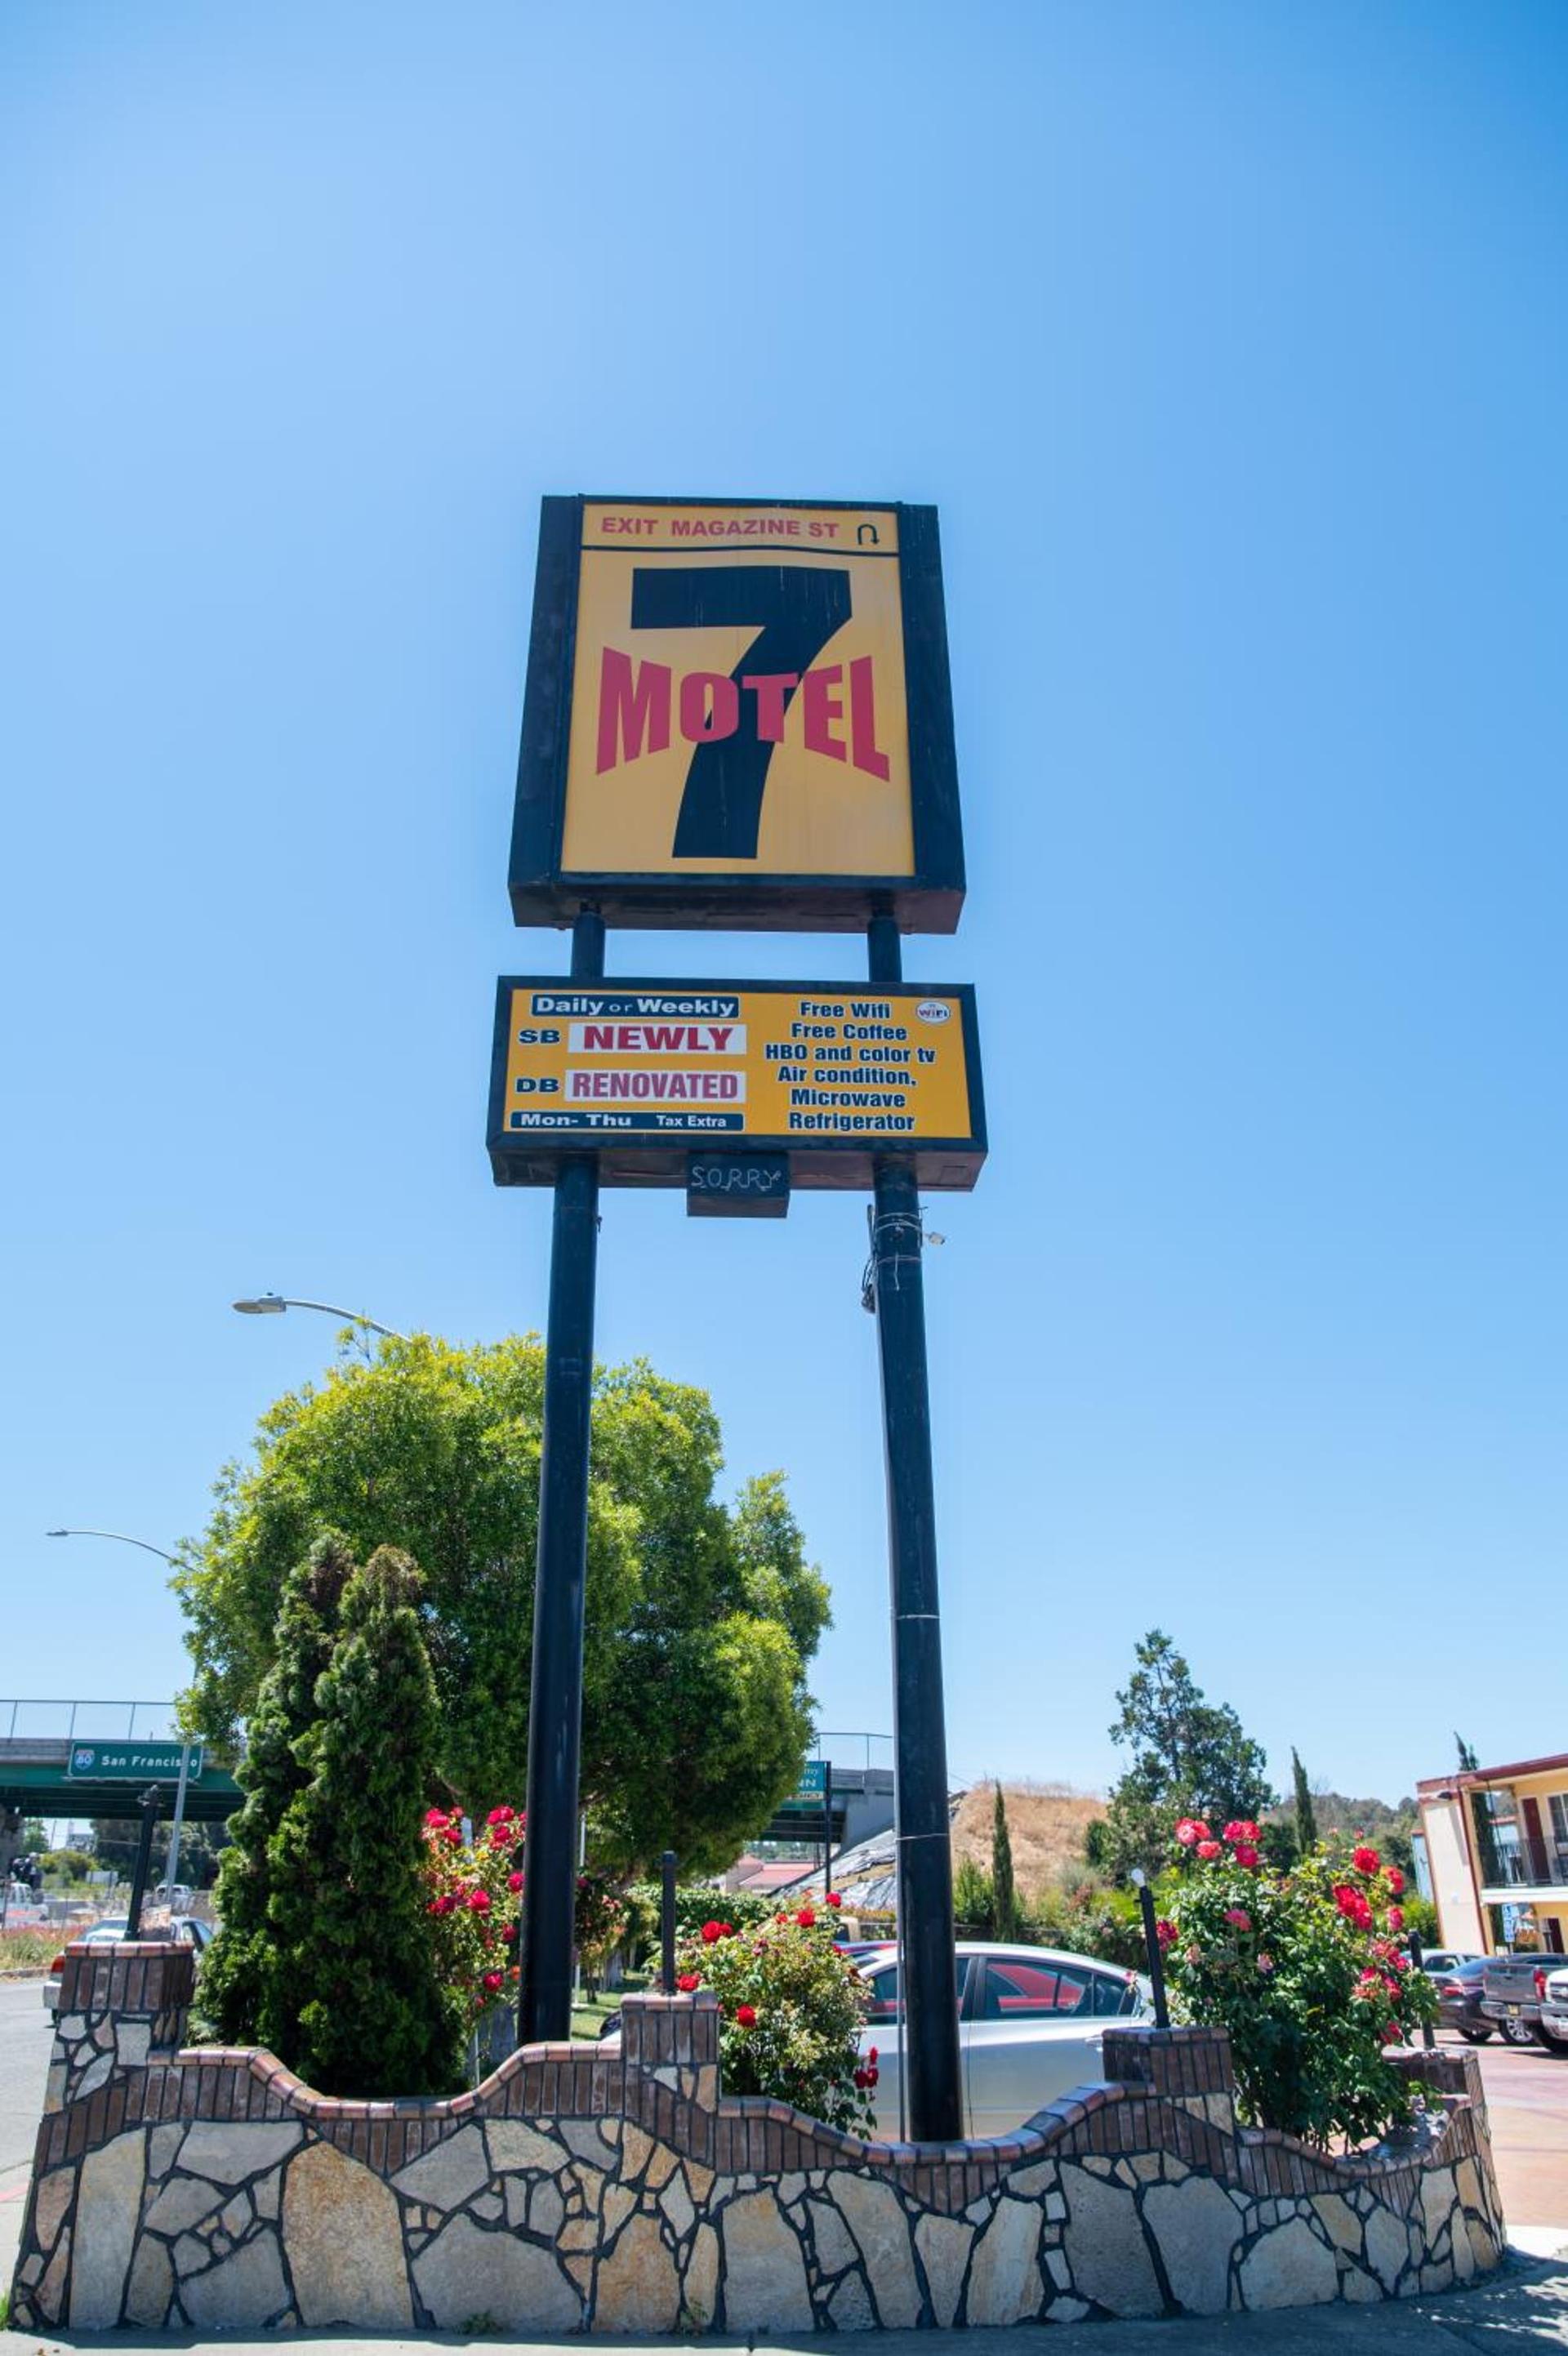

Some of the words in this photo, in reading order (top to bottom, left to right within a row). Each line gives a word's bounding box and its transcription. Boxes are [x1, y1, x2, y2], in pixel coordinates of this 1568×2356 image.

[602, 516, 658, 535] EXIT
[671, 519, 800, 537] MAGAZINE
[808, 522, 840, 538] ST
[596, 646, 890, 782] MOTEL
[630, 565, 853, 859] 7
[536, 996, 604, 1015] Daily
[608, 1003, 631, 1013] or
[637, 999, 734, 1017] Weekly
[800, 1002, 844, 1017] Free
[519, 1030, 560, 1044] SB
[583, 1026, 733, 1050] NEWLY
[791, 1023, 835, 1038] Free
[843, 1024, 906, 1040] Coffee
[765, 1044, 807, 1060] HBO
[815, 1046, 852, 1061] and
[859, 1046, 911, 1062] color
[917, 1048, 935, 1062] tv
[778, 1067, 807, 1082] Air
[516, 1078, 559, 1093] DB
[573, 1073, 737, 1098] RENOVATED
[791, 1089, 905, 1107] Microwave
[586, 1114, 631, 1127] Thu
[657, 1115, 683, 1127] Tax
[688, 1116, 727, 1128] Extra
[790, 1112, 915, 1131] Refrigerator
[691, 1165, 782, 1191] SORRY
[101, 1756, 126, 1766] San
[131, 1756, 198, 1767] Franciso
